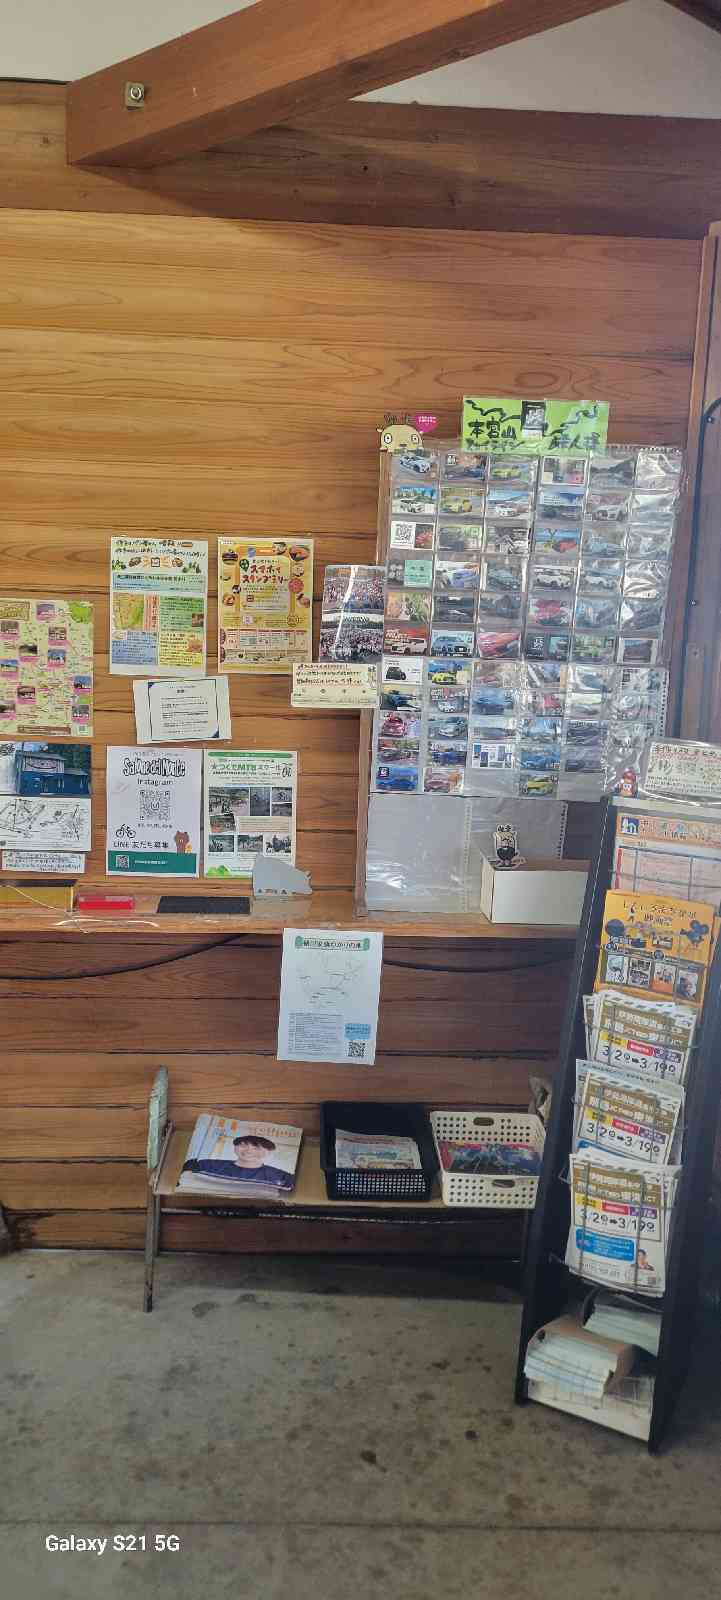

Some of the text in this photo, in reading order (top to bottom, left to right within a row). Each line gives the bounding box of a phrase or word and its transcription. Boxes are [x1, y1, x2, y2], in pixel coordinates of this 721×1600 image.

[468, 416, 517, 440] 本宮山
[137, 778, 174, 787] Instagram
